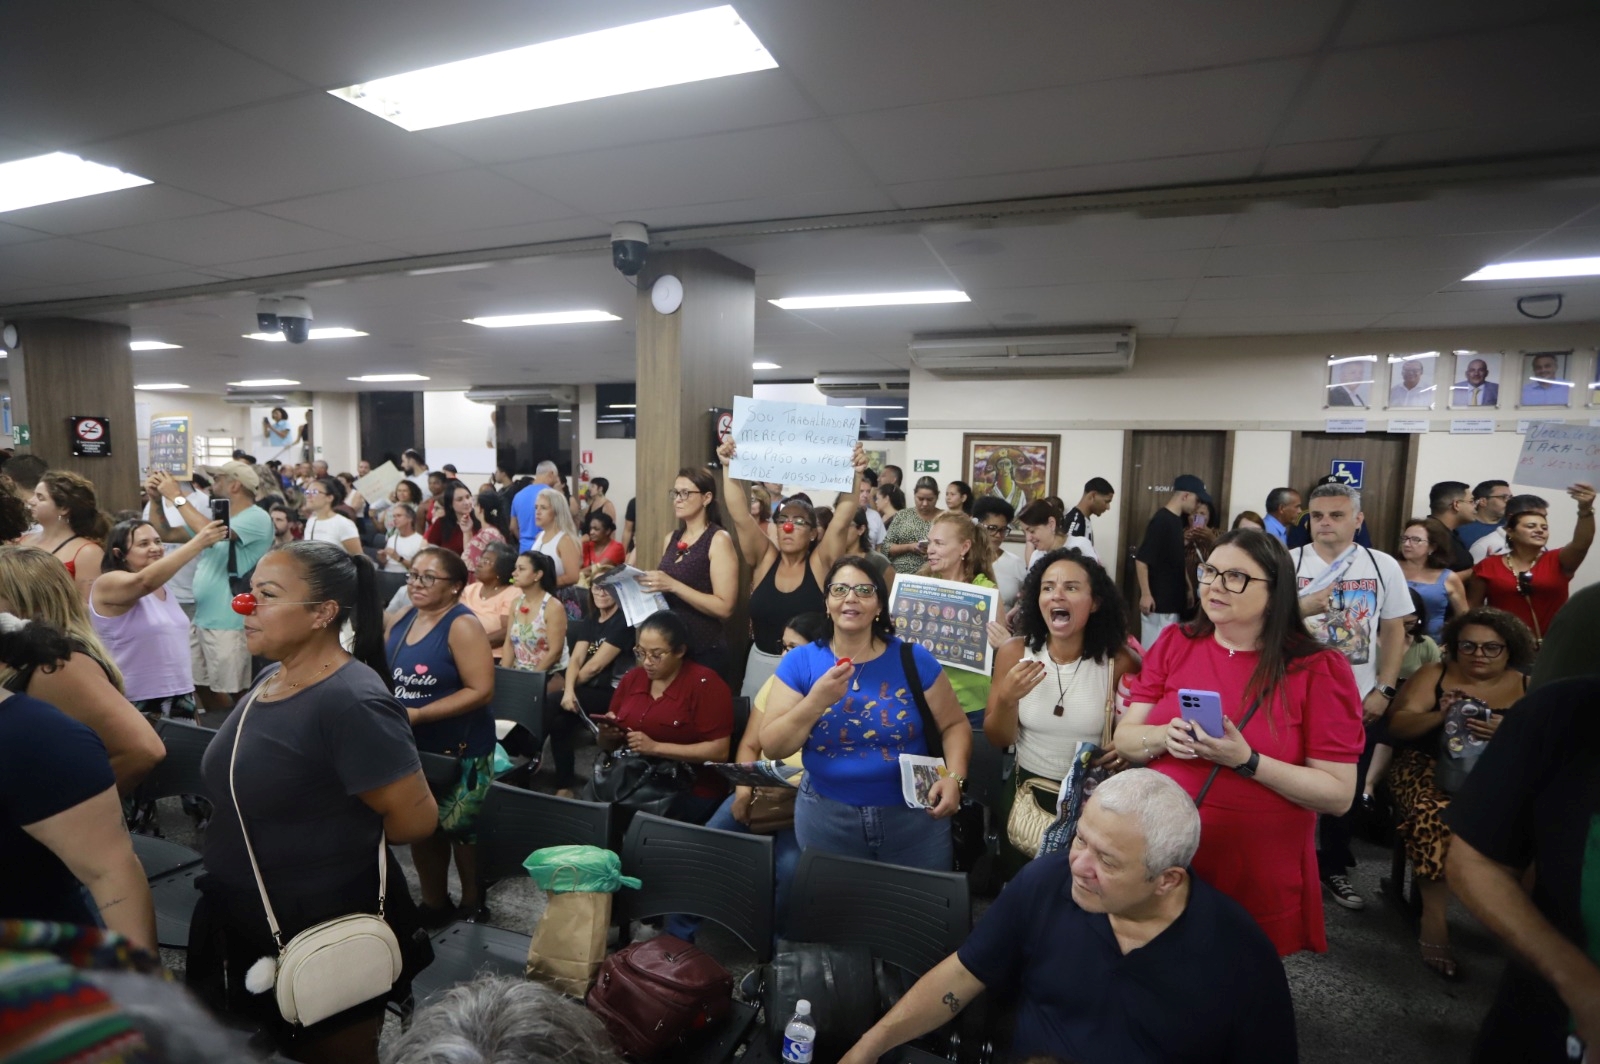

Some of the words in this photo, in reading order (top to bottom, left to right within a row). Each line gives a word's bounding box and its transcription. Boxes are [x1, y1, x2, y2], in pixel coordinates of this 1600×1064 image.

[748, 405, 774, 422] SOU
[741, 429, 796, 446] MEREÇO
[764, 447, 793, 464] PAGO
[782, 472, 816, 482] NOSSO
[392, 667, 437, 686] Perfeito
